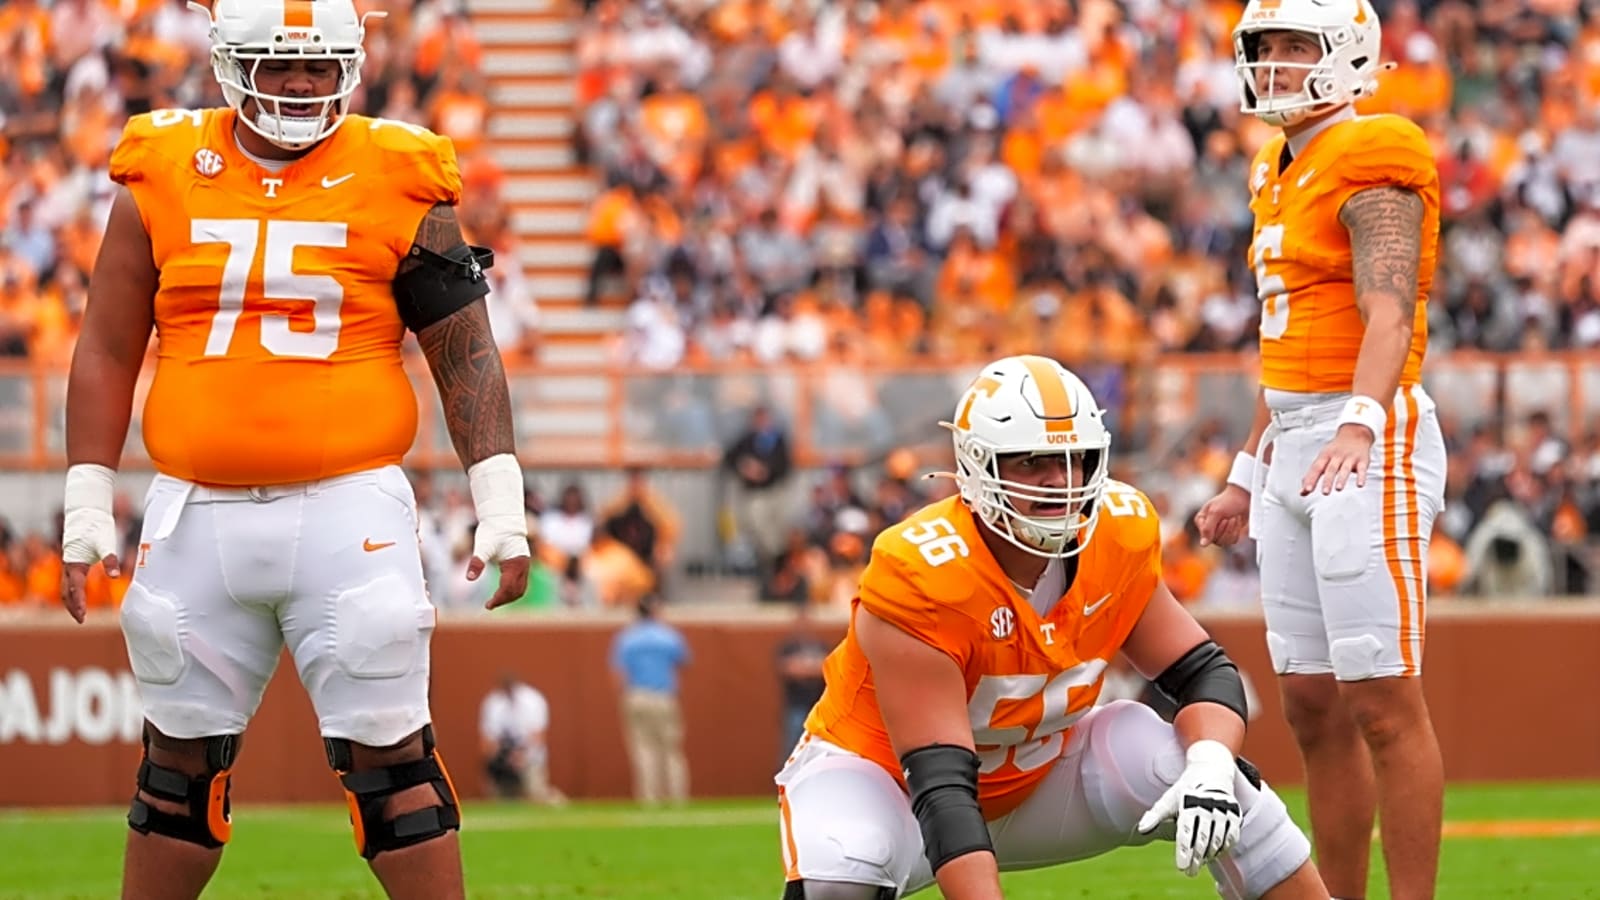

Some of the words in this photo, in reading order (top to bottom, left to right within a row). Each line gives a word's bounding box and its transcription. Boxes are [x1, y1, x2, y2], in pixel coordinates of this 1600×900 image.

[195, 148, 225, 178] SEC
[261, 177, 283, 198] T
[190, 218, 348, 359] 75
[1254, 223, 1291, 340] 6
[956, 375, 1002, 431] T
[1354, 401, 1371, 416] T
[1046, 434, 1078, 444] VOLS
[901, 516, 970, 568] 56
[990, 606, 1015, 640] SEC
[1039, 622, 1056, 646] T
[0, 667, 143, 744] AJO
[967, 657, 1108, 775] 56
